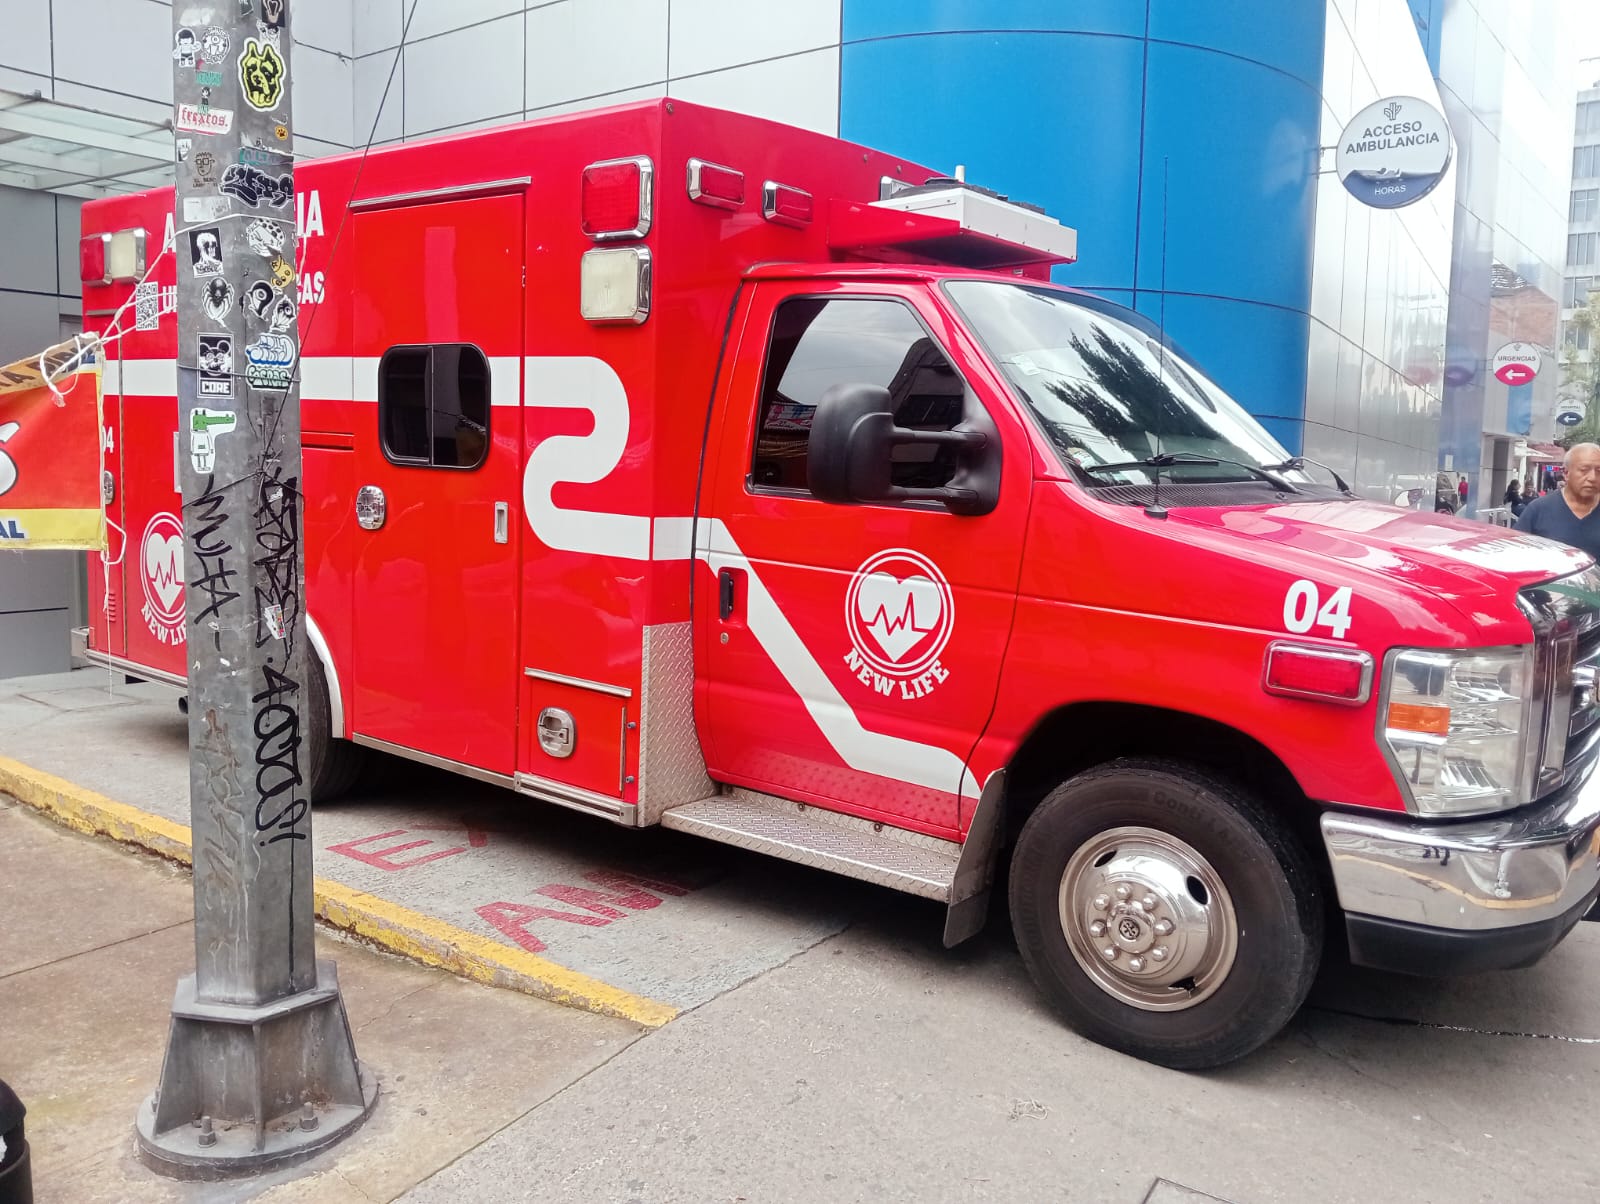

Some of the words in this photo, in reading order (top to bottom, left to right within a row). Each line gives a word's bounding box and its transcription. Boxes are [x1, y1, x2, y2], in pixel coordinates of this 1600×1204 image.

[1362, 121, 1422, 138] ACCESO
[1345, 132, 1440, 154] AMBULANCIA
[1375, 184, 1406, 195] HORAS
[201, 381, 231, 394] CORE
[1283, 579, 1353, 640] 04
[141, 601, 169, 643] NEW
[843, 647, 896, 696] NEW
[899, 659, 950, 700] LIFE
